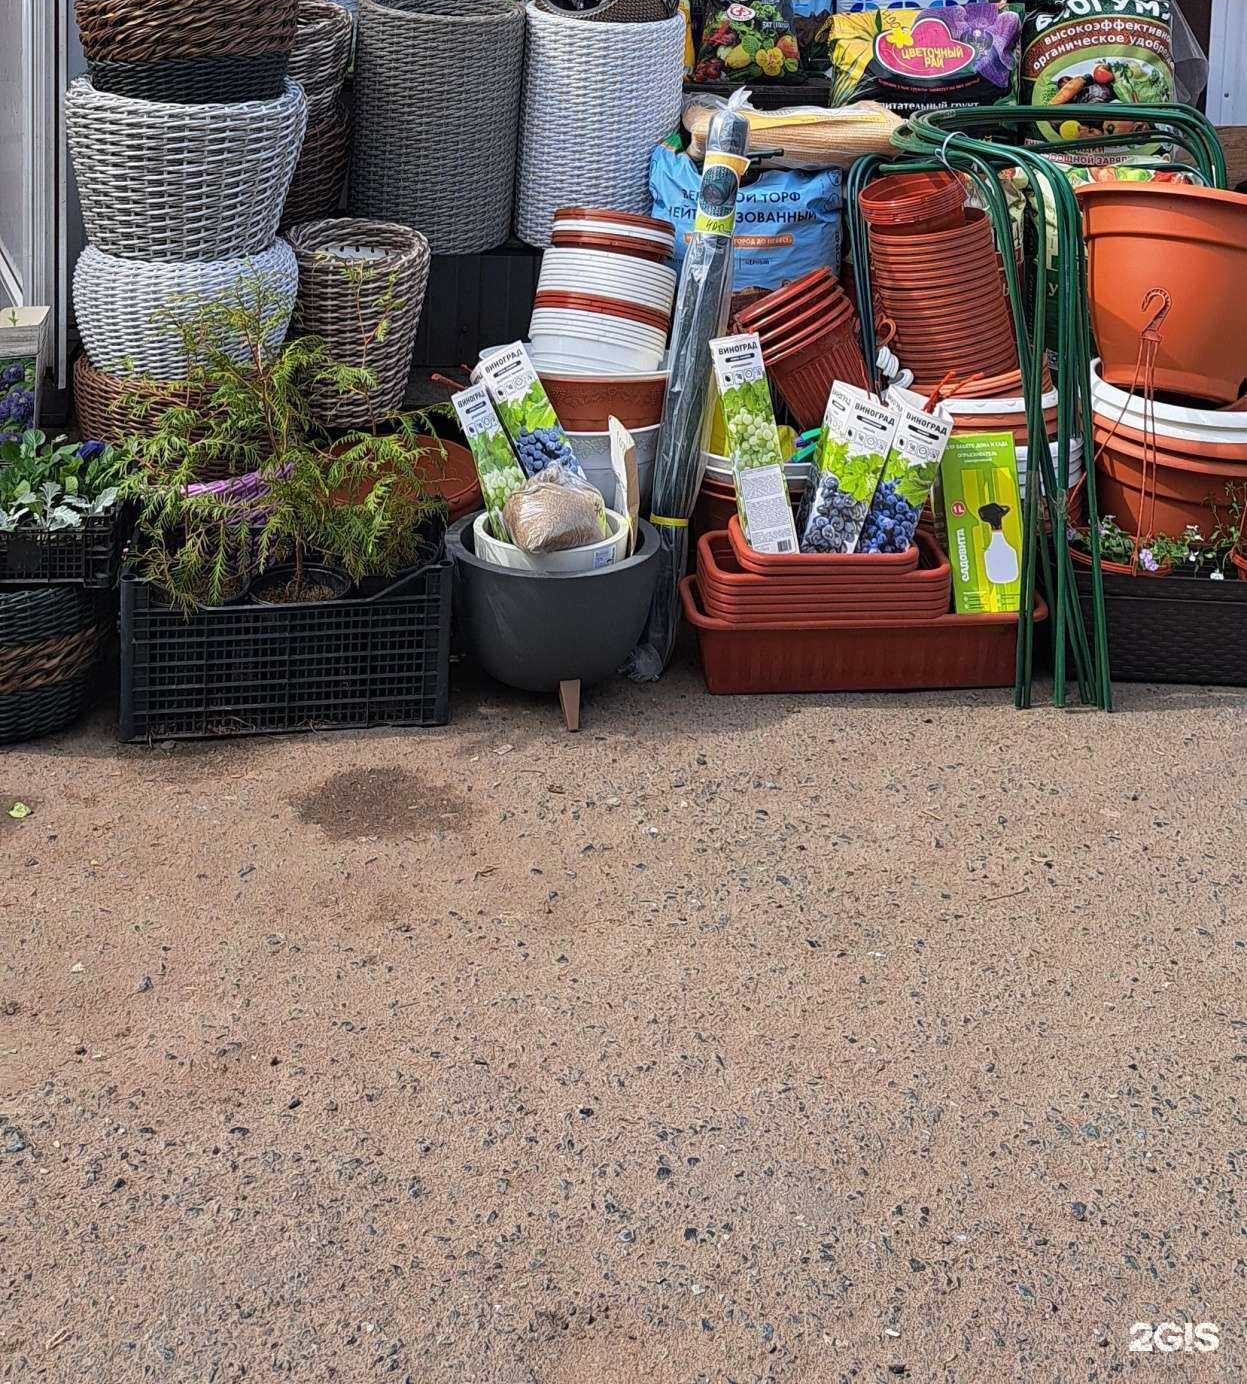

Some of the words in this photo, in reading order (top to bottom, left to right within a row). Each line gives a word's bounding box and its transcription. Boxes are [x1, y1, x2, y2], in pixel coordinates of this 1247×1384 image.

[901, 45, 964, 60] ЦВЕТОЧНЫЙ
[1033, 34, 1125, 71] органическое
[762, 191, 800, 202] ТОРФ
[667, 206, 817, 223] ЕЙТЗОВАННЫЙ
[718, 341, 758, 356] ВИНОГРАД
[485, 349, 524, 374] ВИНОГРАД
[457, 391, 485, 408] ВИНОГРАД
[854, 401, 896, 427] ВИНОГРАД
[906, 412, 948, 436] ВИНОГРАД
